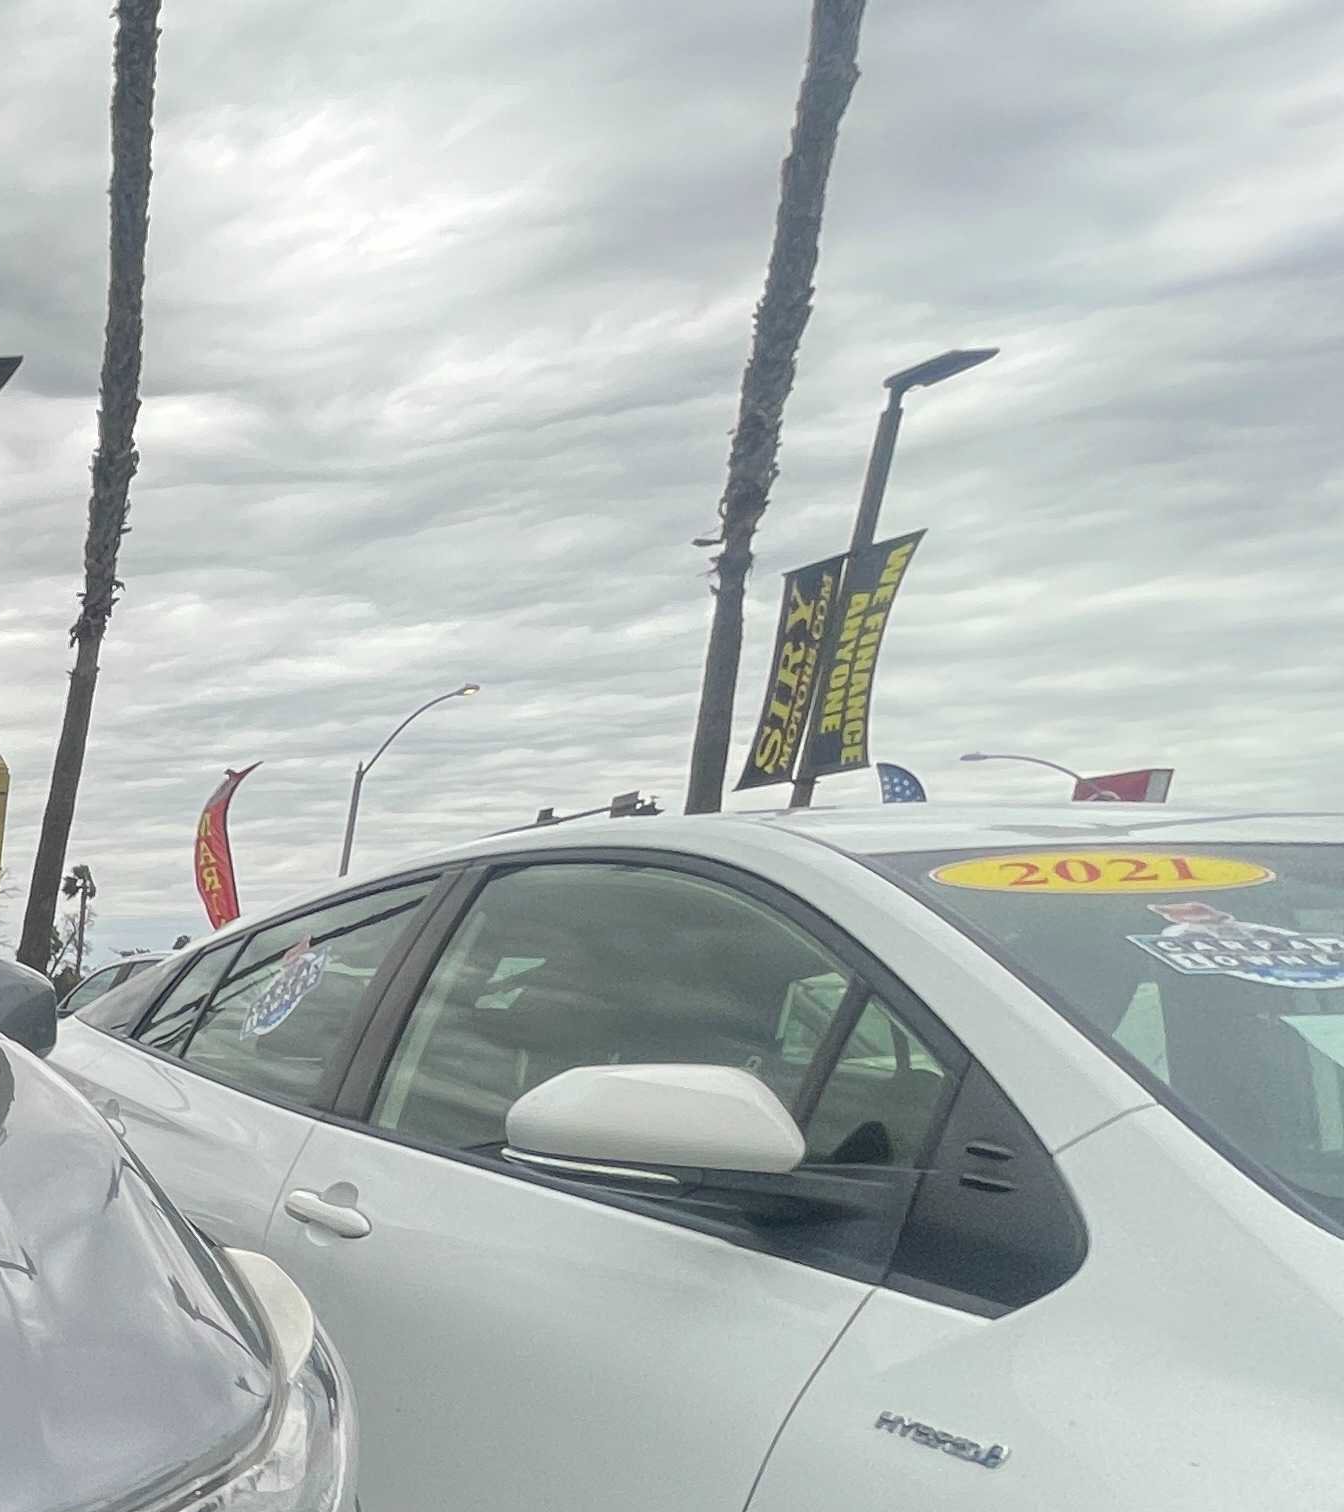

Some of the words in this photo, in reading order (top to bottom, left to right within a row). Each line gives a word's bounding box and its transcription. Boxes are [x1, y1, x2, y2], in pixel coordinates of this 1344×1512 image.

[871, 542, 914, 606] WE
[755, 578, 815, 775] SIRY
[821, 592, 870, 734] ANYONE
[841, 612, 886, 765] FINANCE
[999, 855, 1201, 886] 2021
